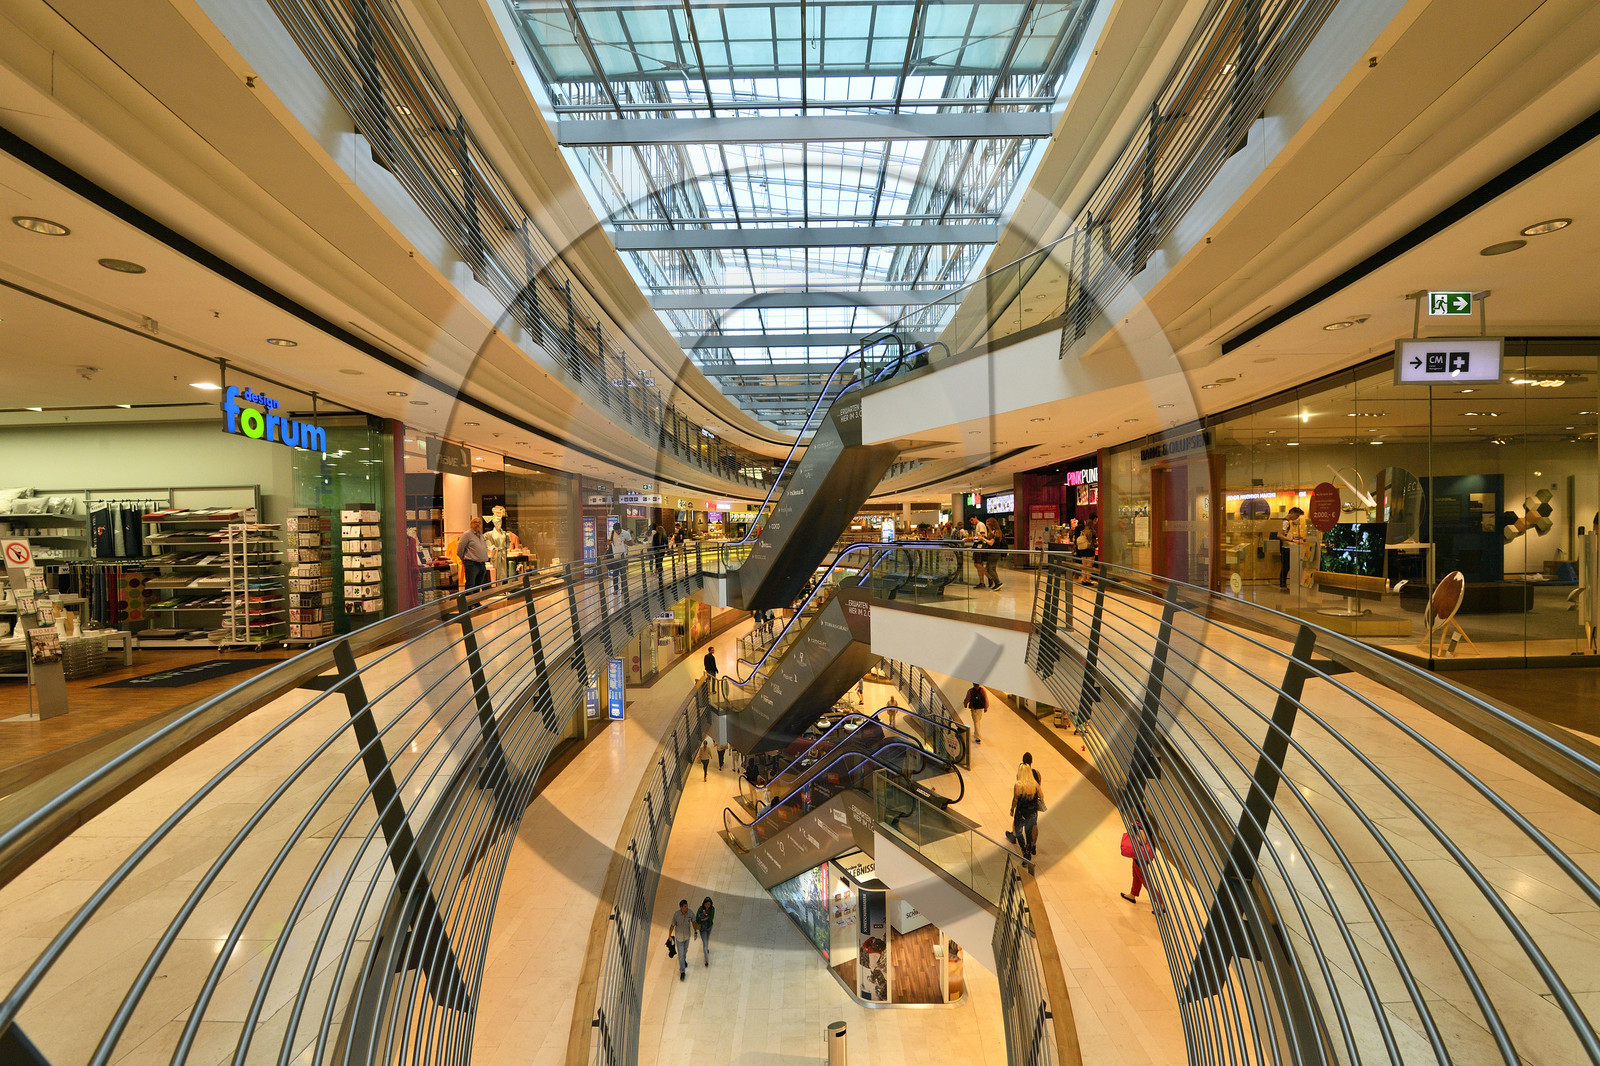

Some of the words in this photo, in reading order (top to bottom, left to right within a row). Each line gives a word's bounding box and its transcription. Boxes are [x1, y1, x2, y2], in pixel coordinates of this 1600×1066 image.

[244, 387, 279, 410] design
[224, 385, 327, 452] forum
[1140, 445, 1161, 460] BANG
[1162, 443, 1168, 456] &
[1168, 431, 1211, 454] OLUFSEN
